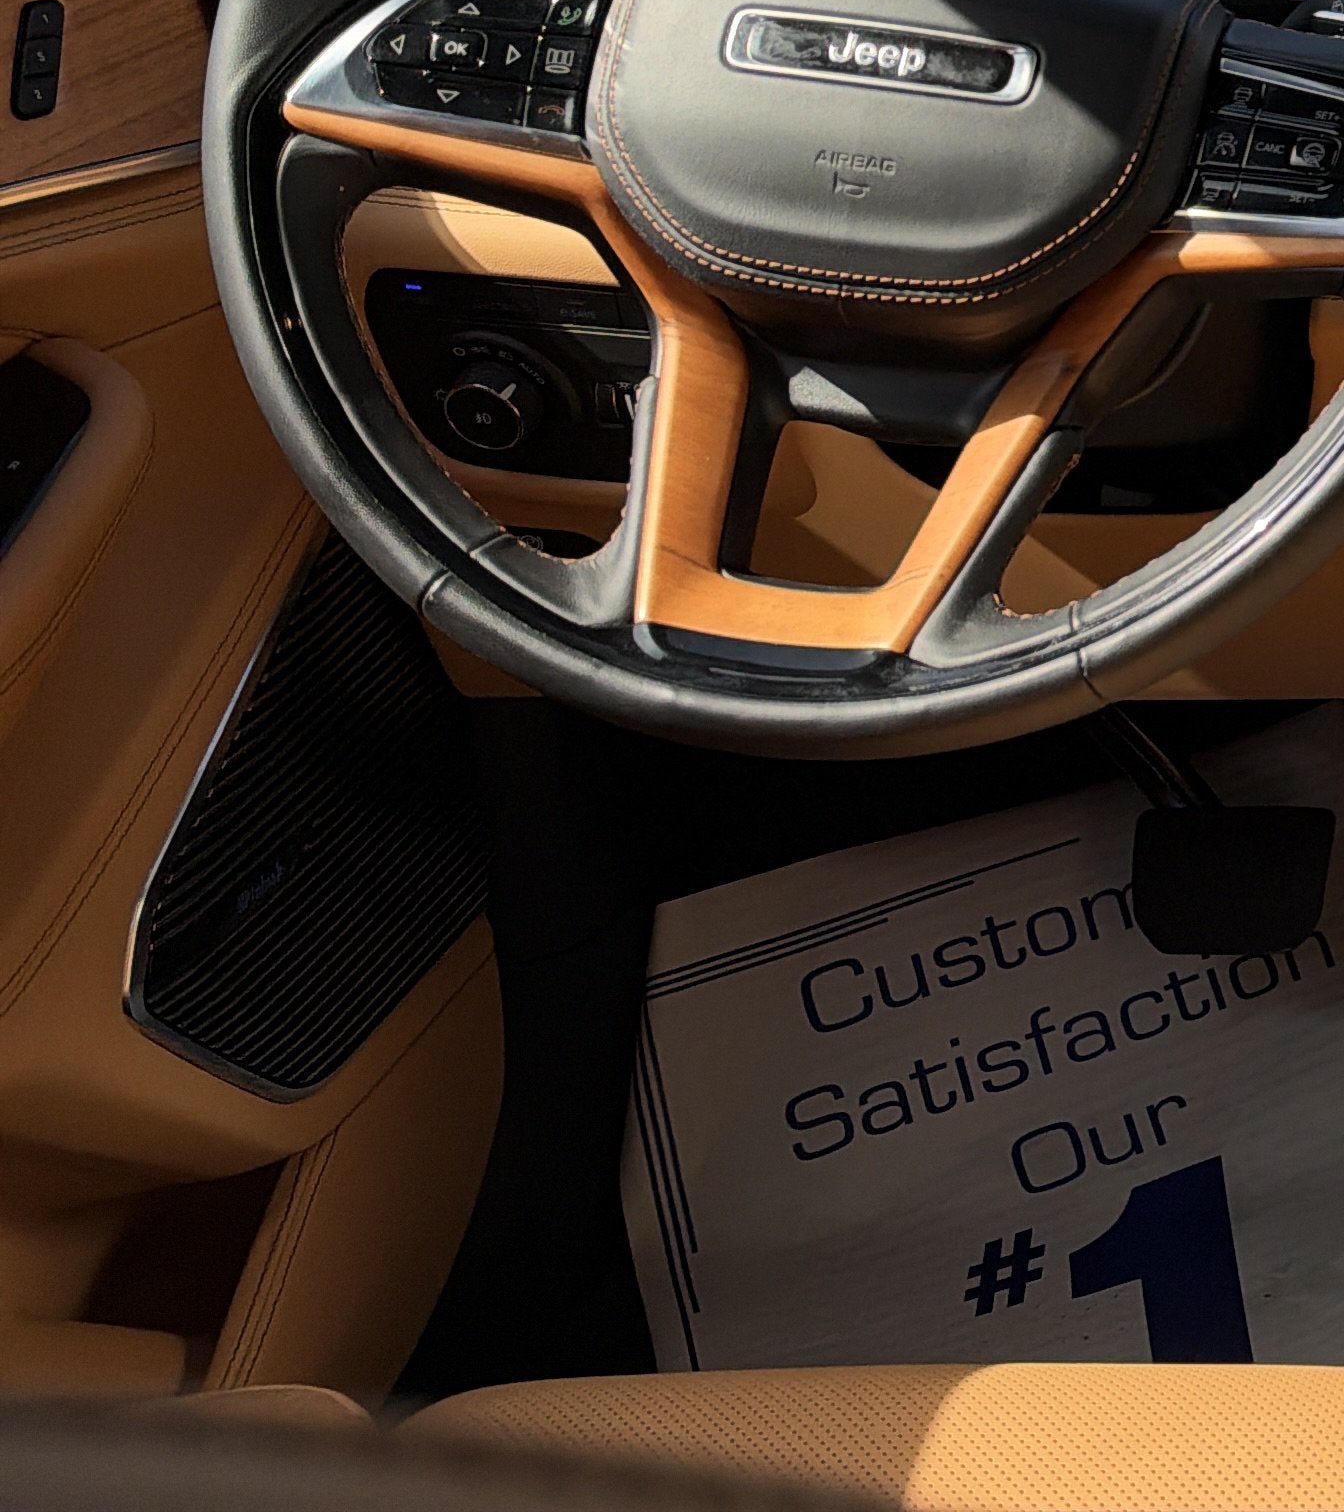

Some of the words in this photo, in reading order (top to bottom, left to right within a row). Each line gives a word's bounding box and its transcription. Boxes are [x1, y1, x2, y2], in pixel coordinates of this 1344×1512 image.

[444, 41, 470, 57] OK
[828, 31, 926, 76] Jeep
[815, 149, 897, 176] AIRBAG
[1255, 141, 1286, 155] CANC
[800, 882, 1136, 1033] Custom
[785, 928, 1337, 1161] Satisfaction
[1011, 1094, 1188, 1194] Our
